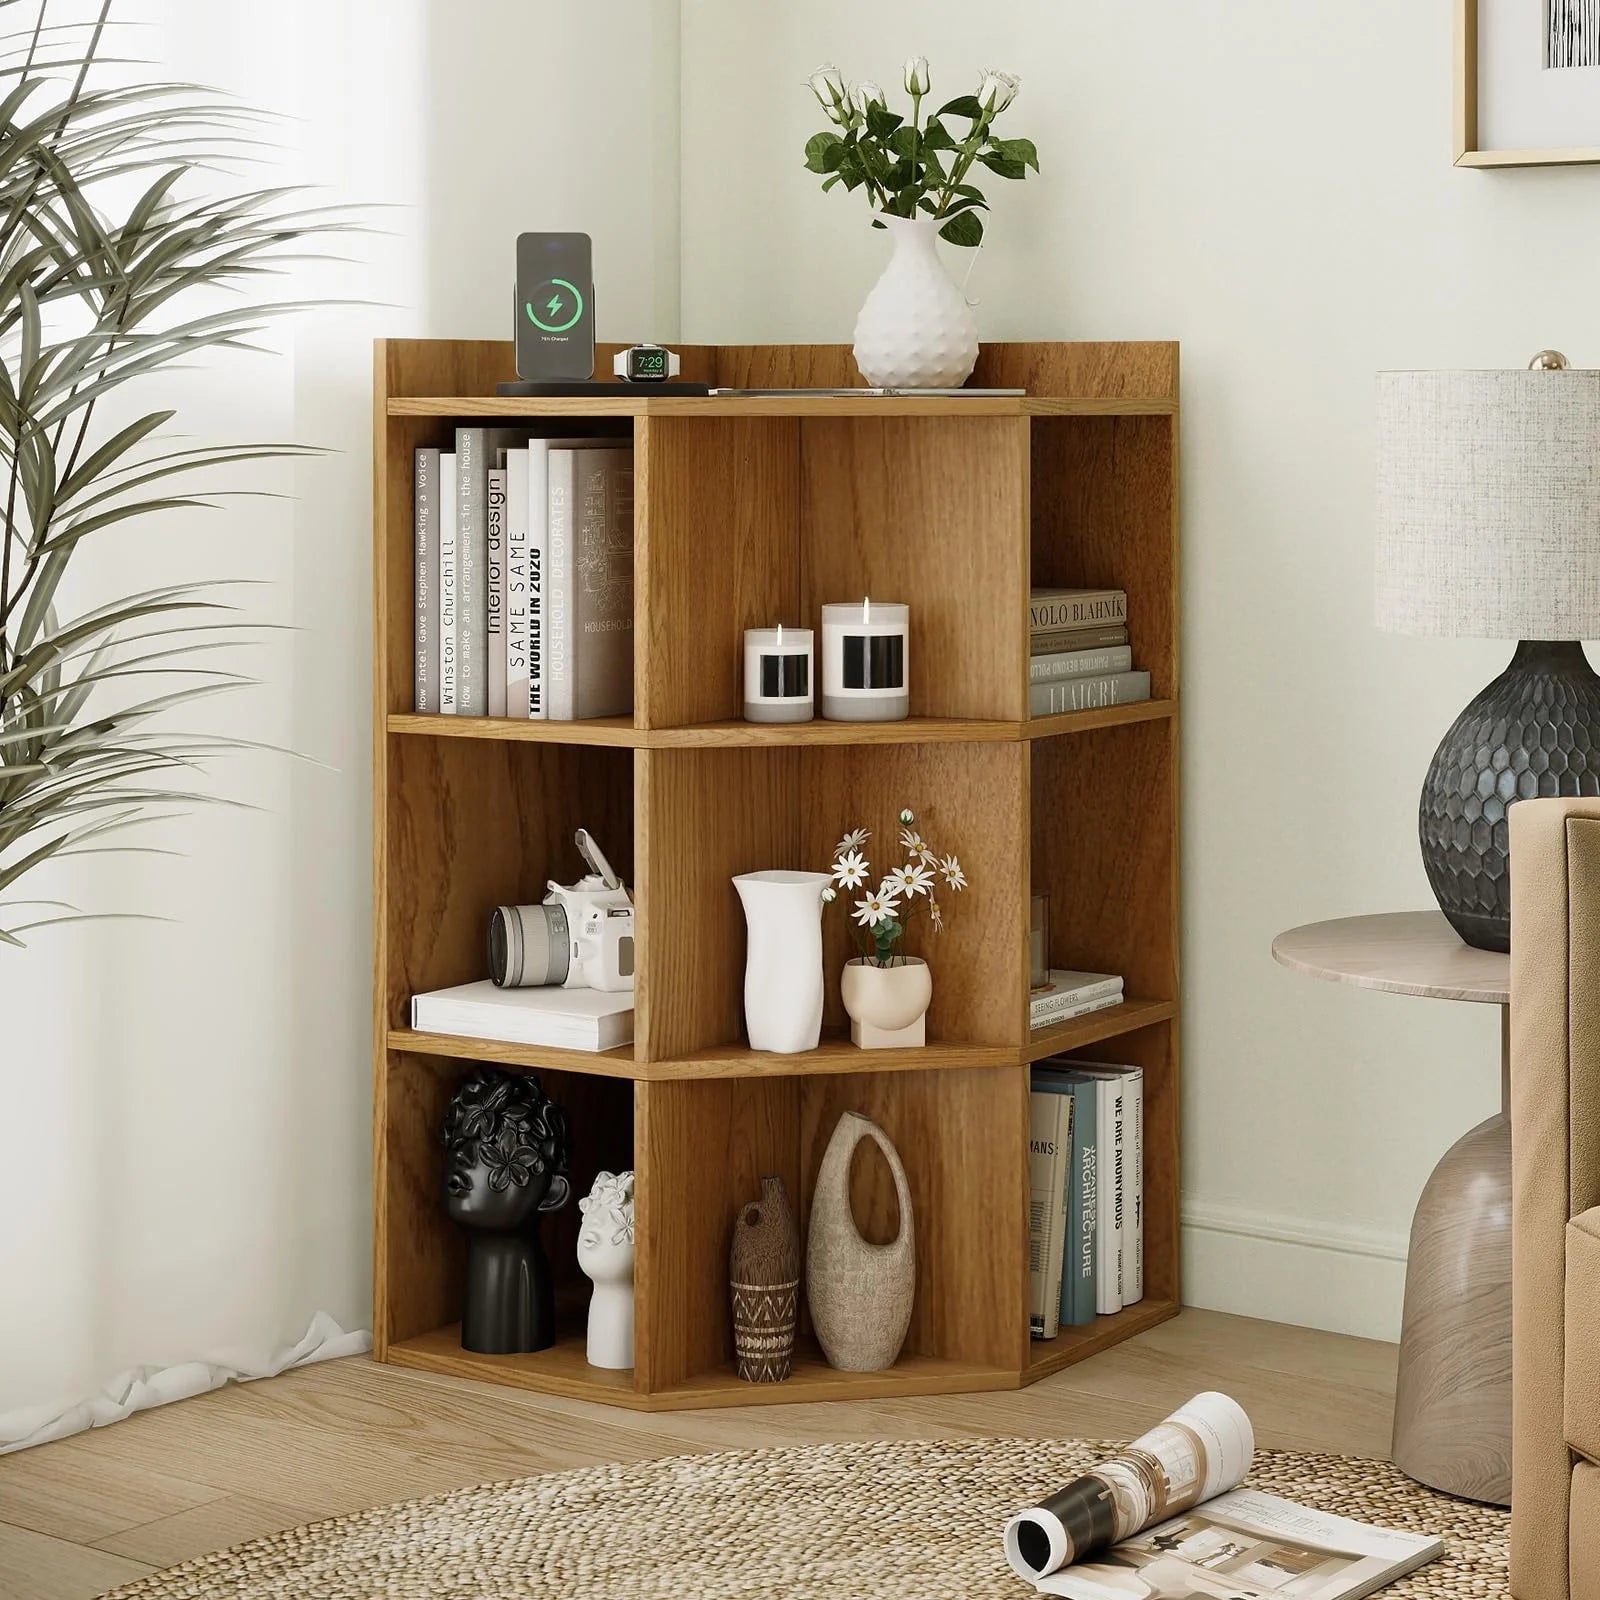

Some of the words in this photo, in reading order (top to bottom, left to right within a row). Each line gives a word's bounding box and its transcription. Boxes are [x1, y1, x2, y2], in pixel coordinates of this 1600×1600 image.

[638, 356, 663, 368] 7:29
[461, 433, 471, 469] house
[418, 454, 427, 488] Voice
[461, 476, 471, 496] the
[461, 504, 471, 519] in
[488, 478, 506, 551] design
[418, 508, 429, 555] Hawking
[551, 487, 564, 578] DECORATES
[462, 526, 473, 602] arrangement
[510, 532, 525, 592] SAME
[529, 548, 541, 593] 2020
[418, 562, 428, 609] Stephen
[443, 540, 454, 626] Churchill
[488, 557, 501, 634] Interior
[462, 609, 471, 623] an
[529, 598, 541, 614] IN
[1030, 604, 1068, 628] NOLO
[418, 615, 427, 643] Gave
[510, 608, 525, 667] SAME
[551, 589, 564, 681] HOUSEHOLD
[584, 619, 632, 633] HOUSEHOLD
[461, 630, 471, 659] make
[529, 619, 541, 680] WORLD
[418, 650, 427, 682] Intel
[443, 637, 454, 705] Winston
[462, 665, 471, 678] to
[418, 688, 427, 710] How
[461, 685, 471, 708] How
[529, 684, 541, 714] THE
[1115, 1096, 1122, 1118] WE
[1082, 1146, 1092, 1278] ARCHITECTURE
